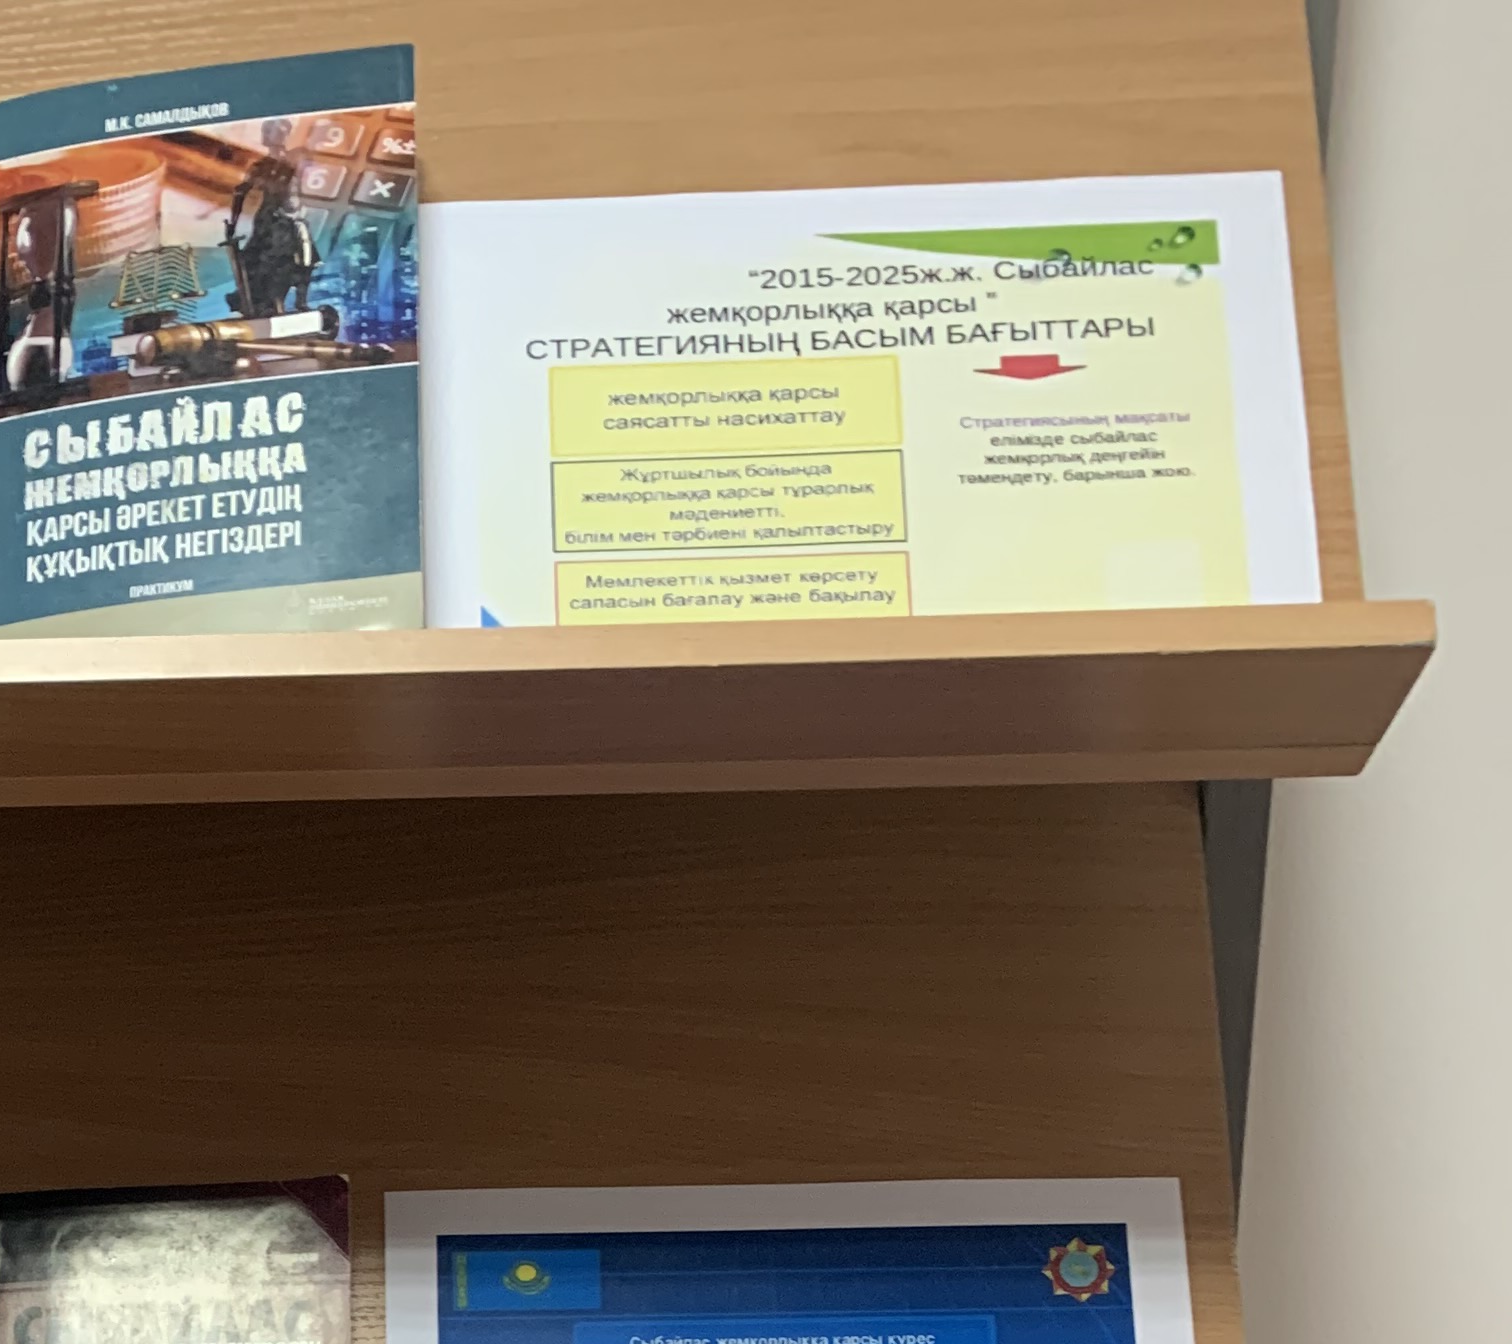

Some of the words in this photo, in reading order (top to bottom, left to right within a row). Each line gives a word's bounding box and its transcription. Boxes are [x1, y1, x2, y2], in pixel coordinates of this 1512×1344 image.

[105, 117, 133, 133] М.К.
[993, 254, 1154, 282] Сыбайлас
[666, 298, 874, 327] жемқорлыққа
[883, 294, 977, 322] қарсы
[526, 326, 802, 361] СТРАТЕГИЯНЫҢ
[810, 324, 935, 353] БАСЫМ
[945, 314, 1156, 346] БАҒЫТТАРЫ
[769, 386, 839, 403] қарсы
[23, 391, 306, 469] СЫБАЙЛАС
[603, 412, 710, 431] саясатты
[718, 409, 846, 427] насихаттау
[24, 443, 307, 509] ЖЕМҚОРЛЫҚҚА
[26, 507, 111, 547] ҚАРСЫ
[116, 495, 205, 533] ӘРЕКЕТ
[211, 484, 302, 521] ЕТУДІҢ
[26, 545, 169, 584] ҚҰҚЫҚТЫҚ
[175, 521, 302, 559] НЕГІЗДЕРІ
[129, 579, 194, 599] ПРАКТИКУМ
[586, 572, 714, 589] Мемлекеттік
[569, 593, 656, 611] сапасын
